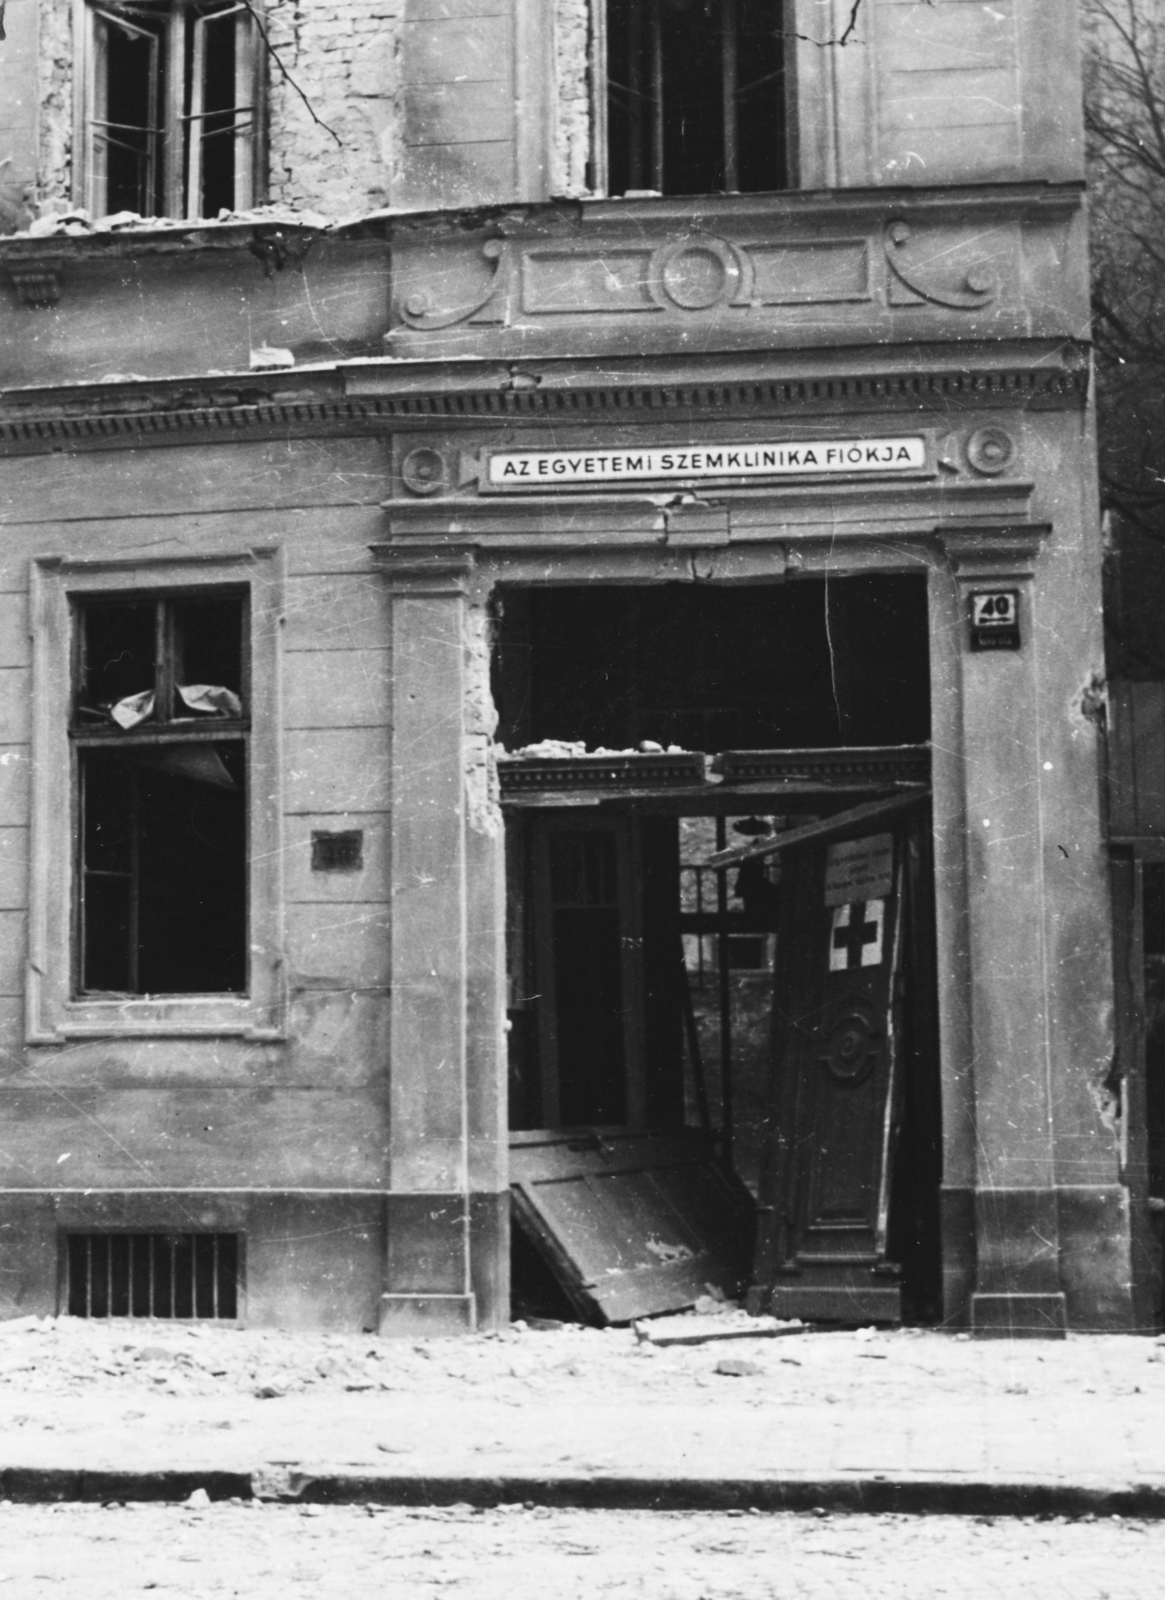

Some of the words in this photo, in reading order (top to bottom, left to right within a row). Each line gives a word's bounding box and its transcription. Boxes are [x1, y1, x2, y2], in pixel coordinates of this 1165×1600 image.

[503, 460, 531, 477] AZ
[537, 455, 653, 475] EGYETEMI
[660, 449, 818, 470] SZEMKLINIKA
[826, 443, 911, 464] FIÓKJA
[980, 595, 1010, 616] 40
